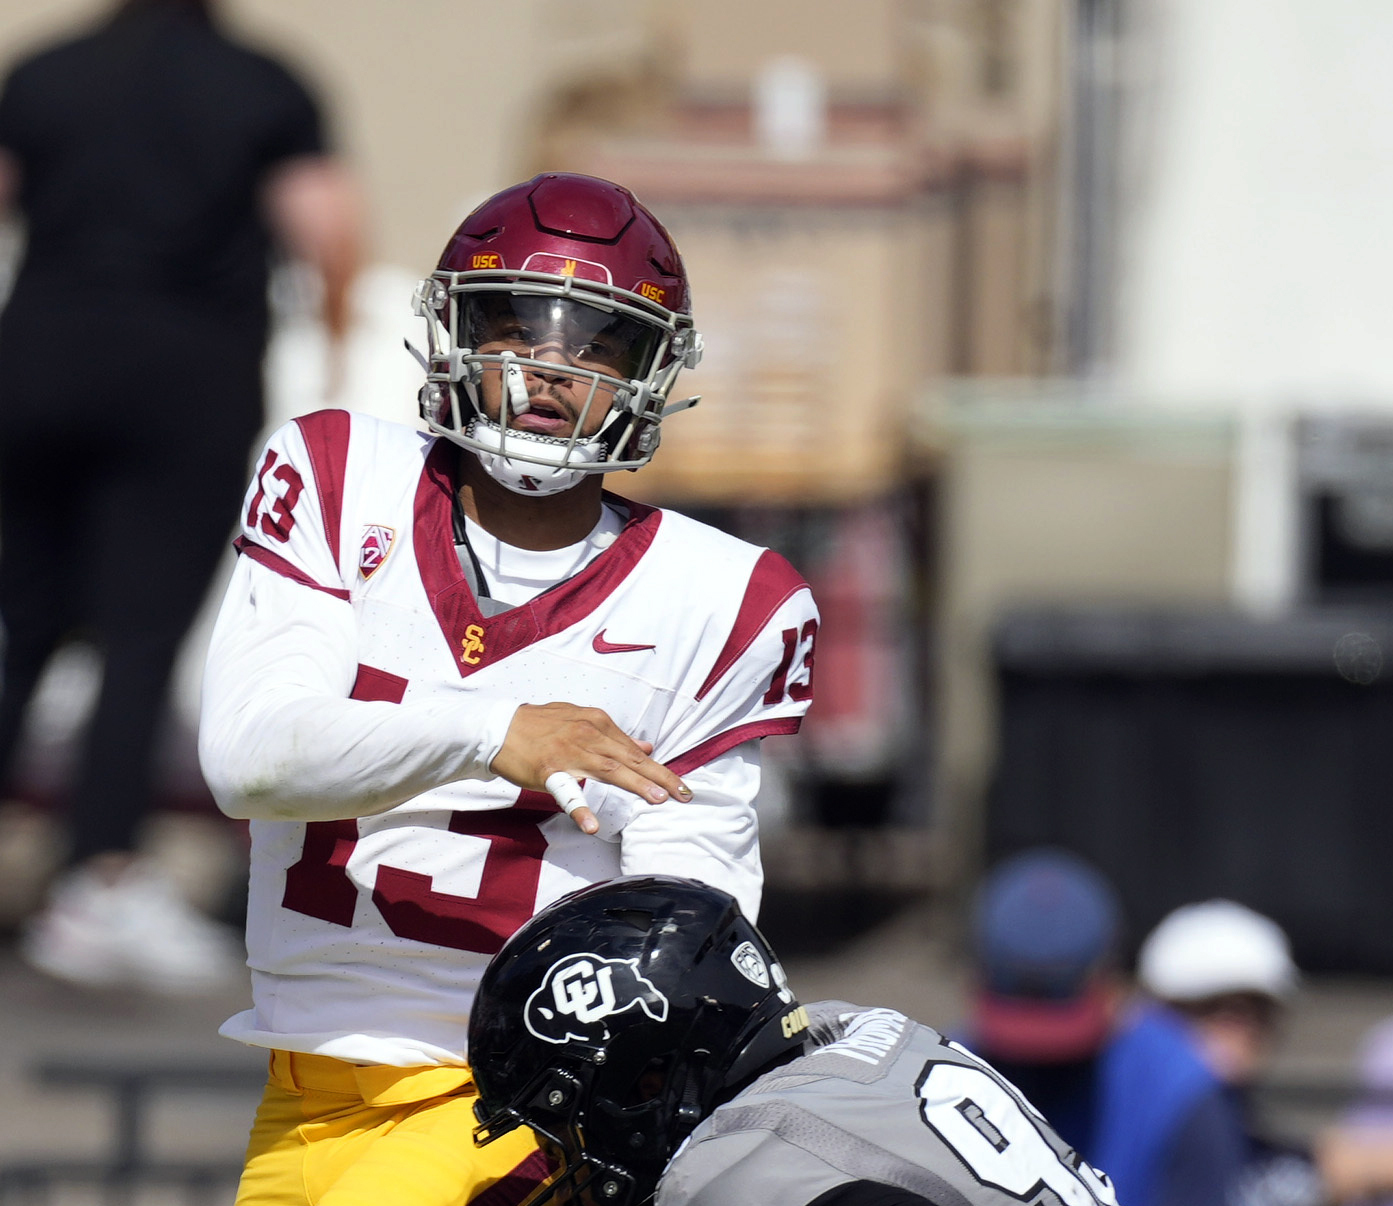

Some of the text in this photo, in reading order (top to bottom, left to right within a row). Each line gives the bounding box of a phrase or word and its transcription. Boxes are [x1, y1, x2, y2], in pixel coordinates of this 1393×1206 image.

[472, 254, 498, 269] USC
[641, 283, 665, 303] USC
[246, 448, 305, 544] 13
[763, 617, 818, 706] 13
[551, 959, 617, 1024] CU
